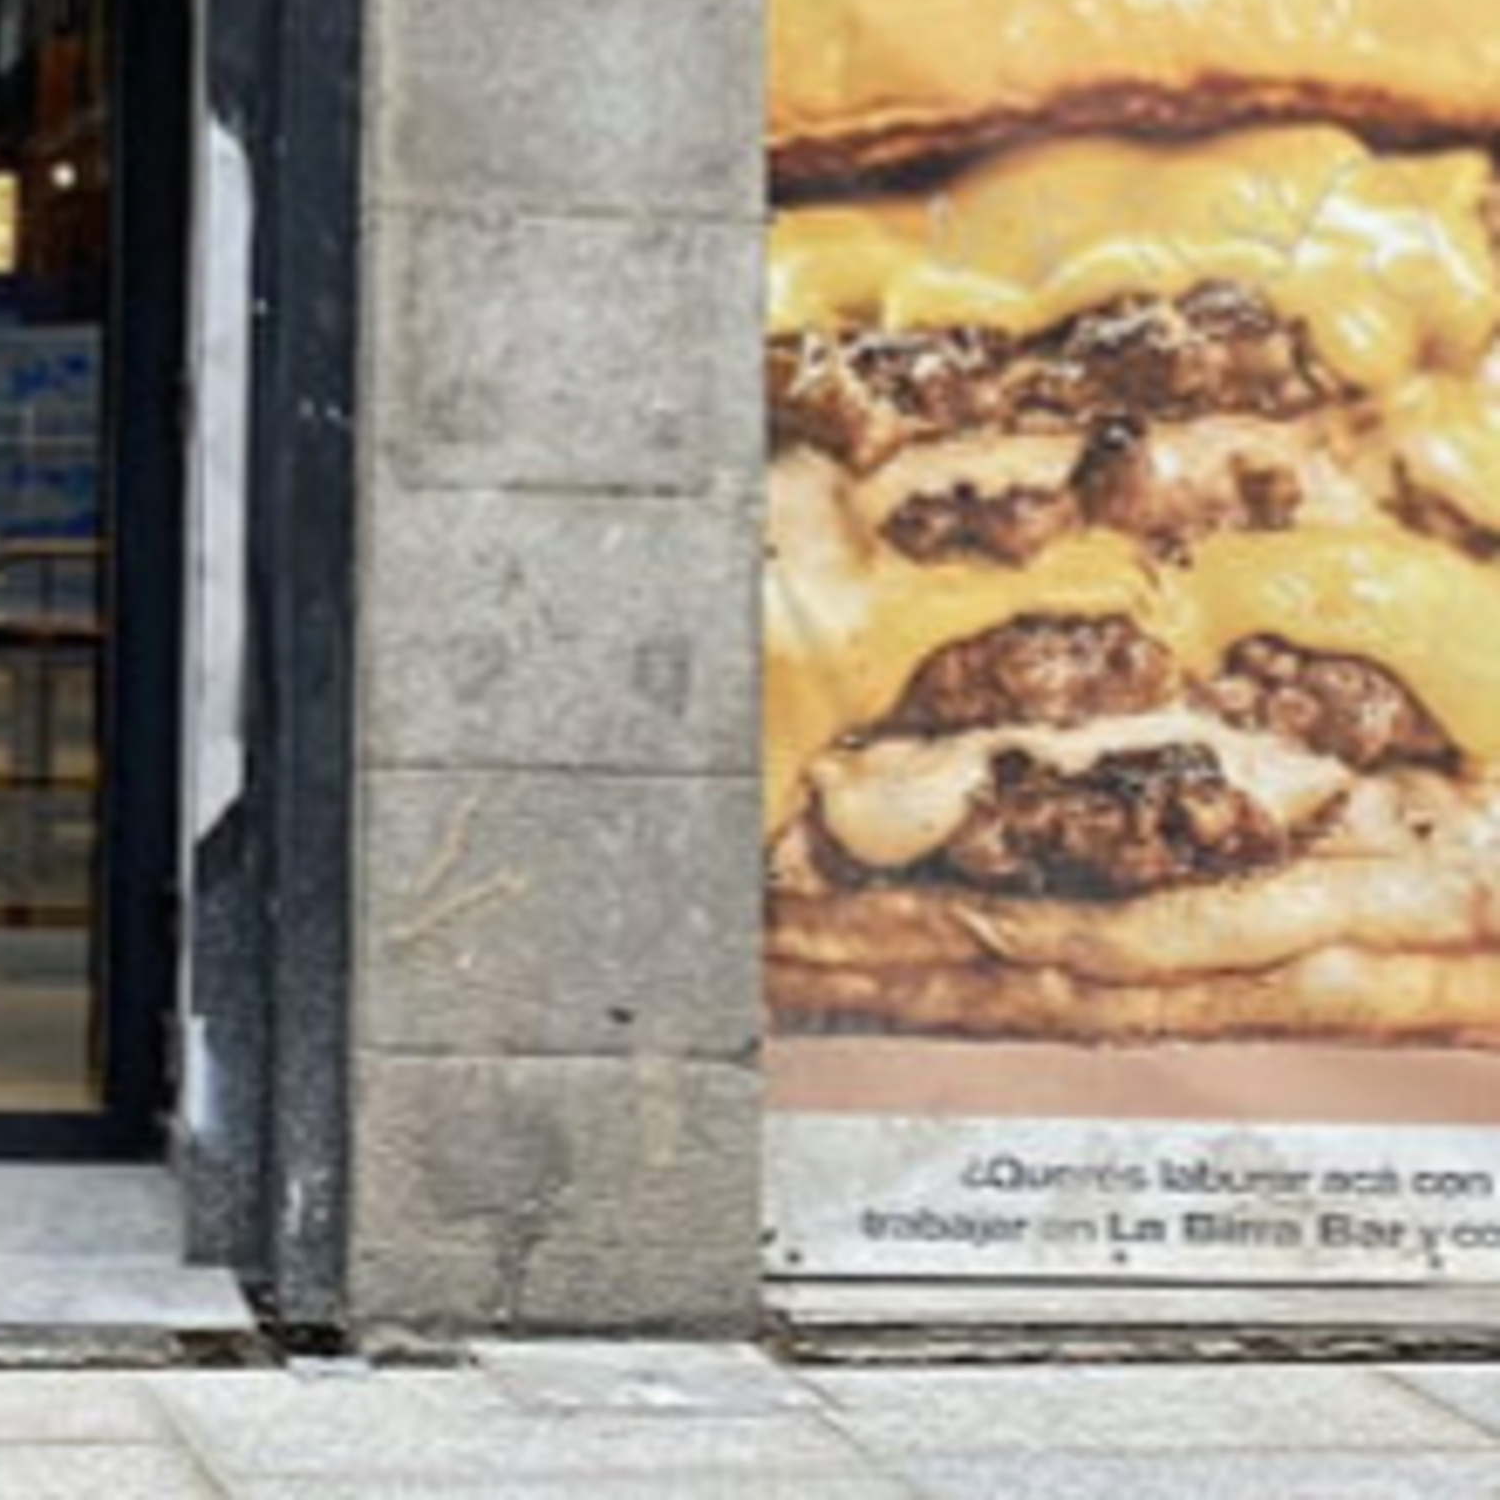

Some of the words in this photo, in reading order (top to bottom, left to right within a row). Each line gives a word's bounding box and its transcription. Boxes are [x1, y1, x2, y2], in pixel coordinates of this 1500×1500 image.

[1411, 1170, 1494, 1196] con
[860, 1206, 1032, 1247] trabajar
[1106, 1209, 1168, 1243] La
[1315, 1212, 1408, 1248] Bar
